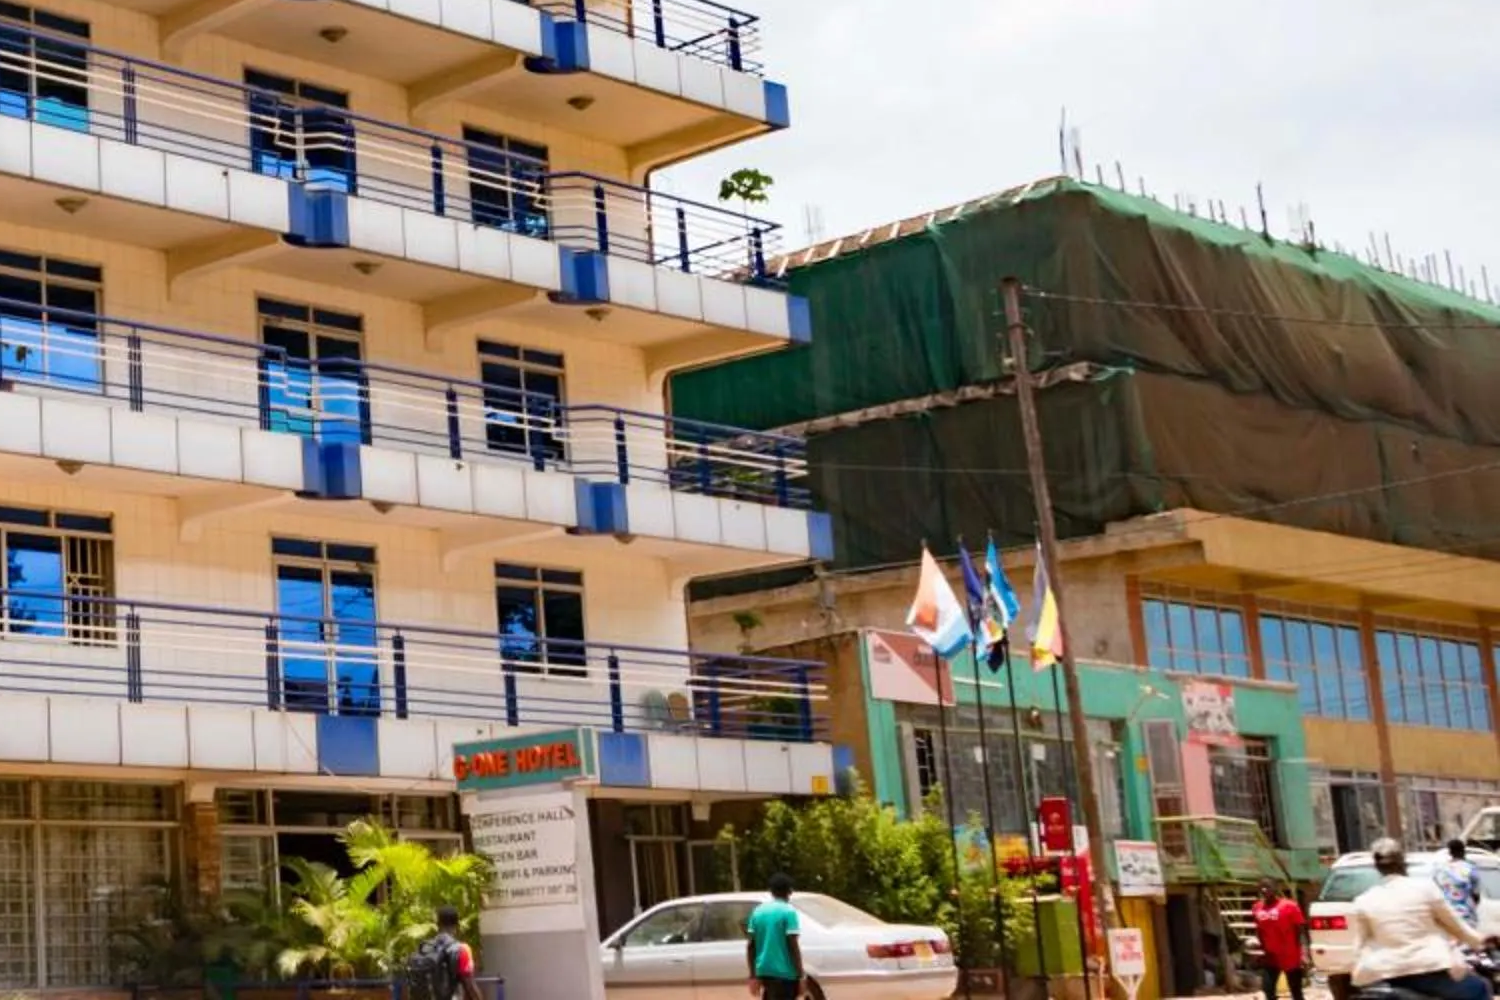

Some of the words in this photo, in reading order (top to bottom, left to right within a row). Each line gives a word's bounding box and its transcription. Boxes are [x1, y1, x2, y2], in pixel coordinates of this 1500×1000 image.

[453, 750, 509, 780] G-ONE
[516, 743, 582, 773] HOTEL
[517, 848, 538, 861] BAR
